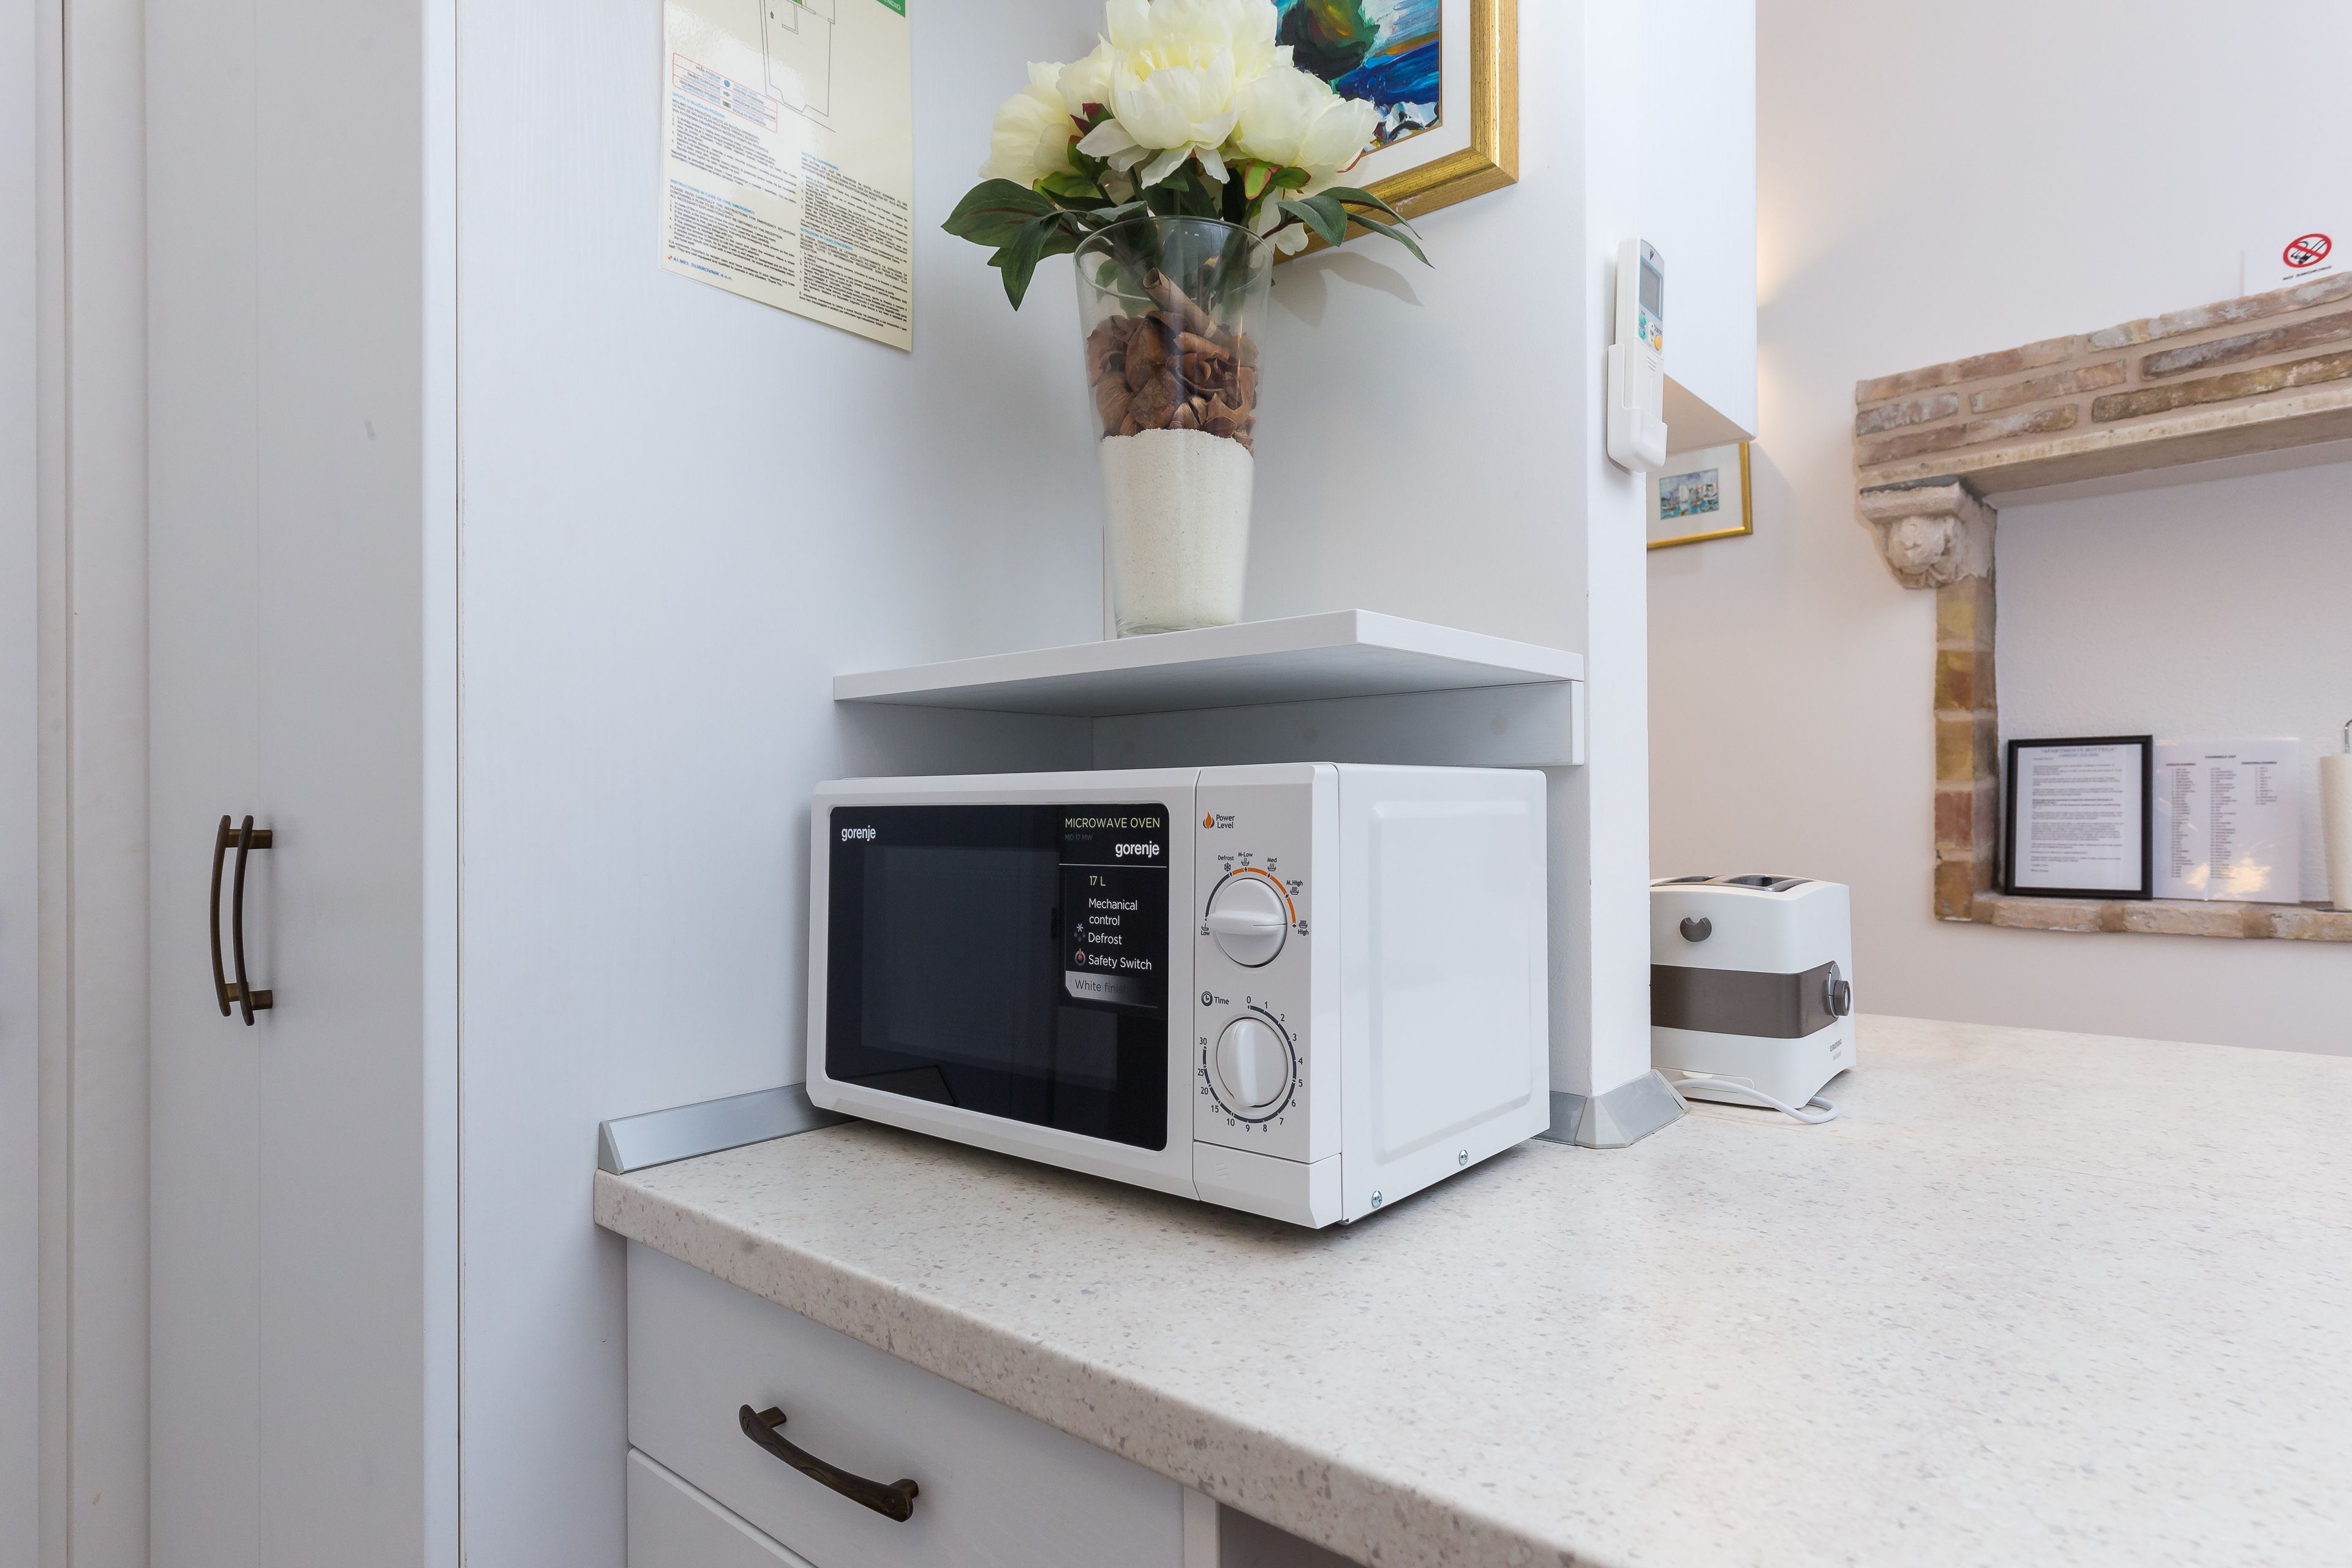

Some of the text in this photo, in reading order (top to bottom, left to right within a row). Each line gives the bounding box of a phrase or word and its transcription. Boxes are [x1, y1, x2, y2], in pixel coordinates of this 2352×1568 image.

[1216, 813, 1236, 823] Power
[1065, 817, 1161, 829] MICROWAVE OVEN
[841, 824, 876, 842] gorenje
[1115, 840, 1160, 858] gorenje
[1089, 875, 1106, 887] 17 L
[1088, 897, 1138, 911] Mechanical
[1089, 914, 1120, 926] control
[1088, 932, 1122, 945] Defrost
[1088, 954, 1152, 970] Safety Switch
[1074, 979, 1102, 992] White
[1214, 997, 1230, 1005] Time
[1246, 995, 1251, 1004] 0
[1264, 1001, 1268, 1009] 1
[1280, 1013, 1285, 1022] 2
[1199, 1036, 1207, 1046] 30
[1292, 1033, 1297, 1042] 3
[1297, 1057, 1303, 1065] 4
[1197, 1068, 1205, 1077] 25
[1298, 1079, 1303, 1087] 5
[1200, 1086, 1209, 1095] 20
[1291, 1099, 1296, 1107] 6
[1210, 1104, 1219, 1114] 15
[1226, 1118, 1235, 1127] 10
[1279, 1117, 1284, 1126] 7
[1245, 1124, 1250, 1133] 9
[1262, 1124, 1268, 1133] 8
